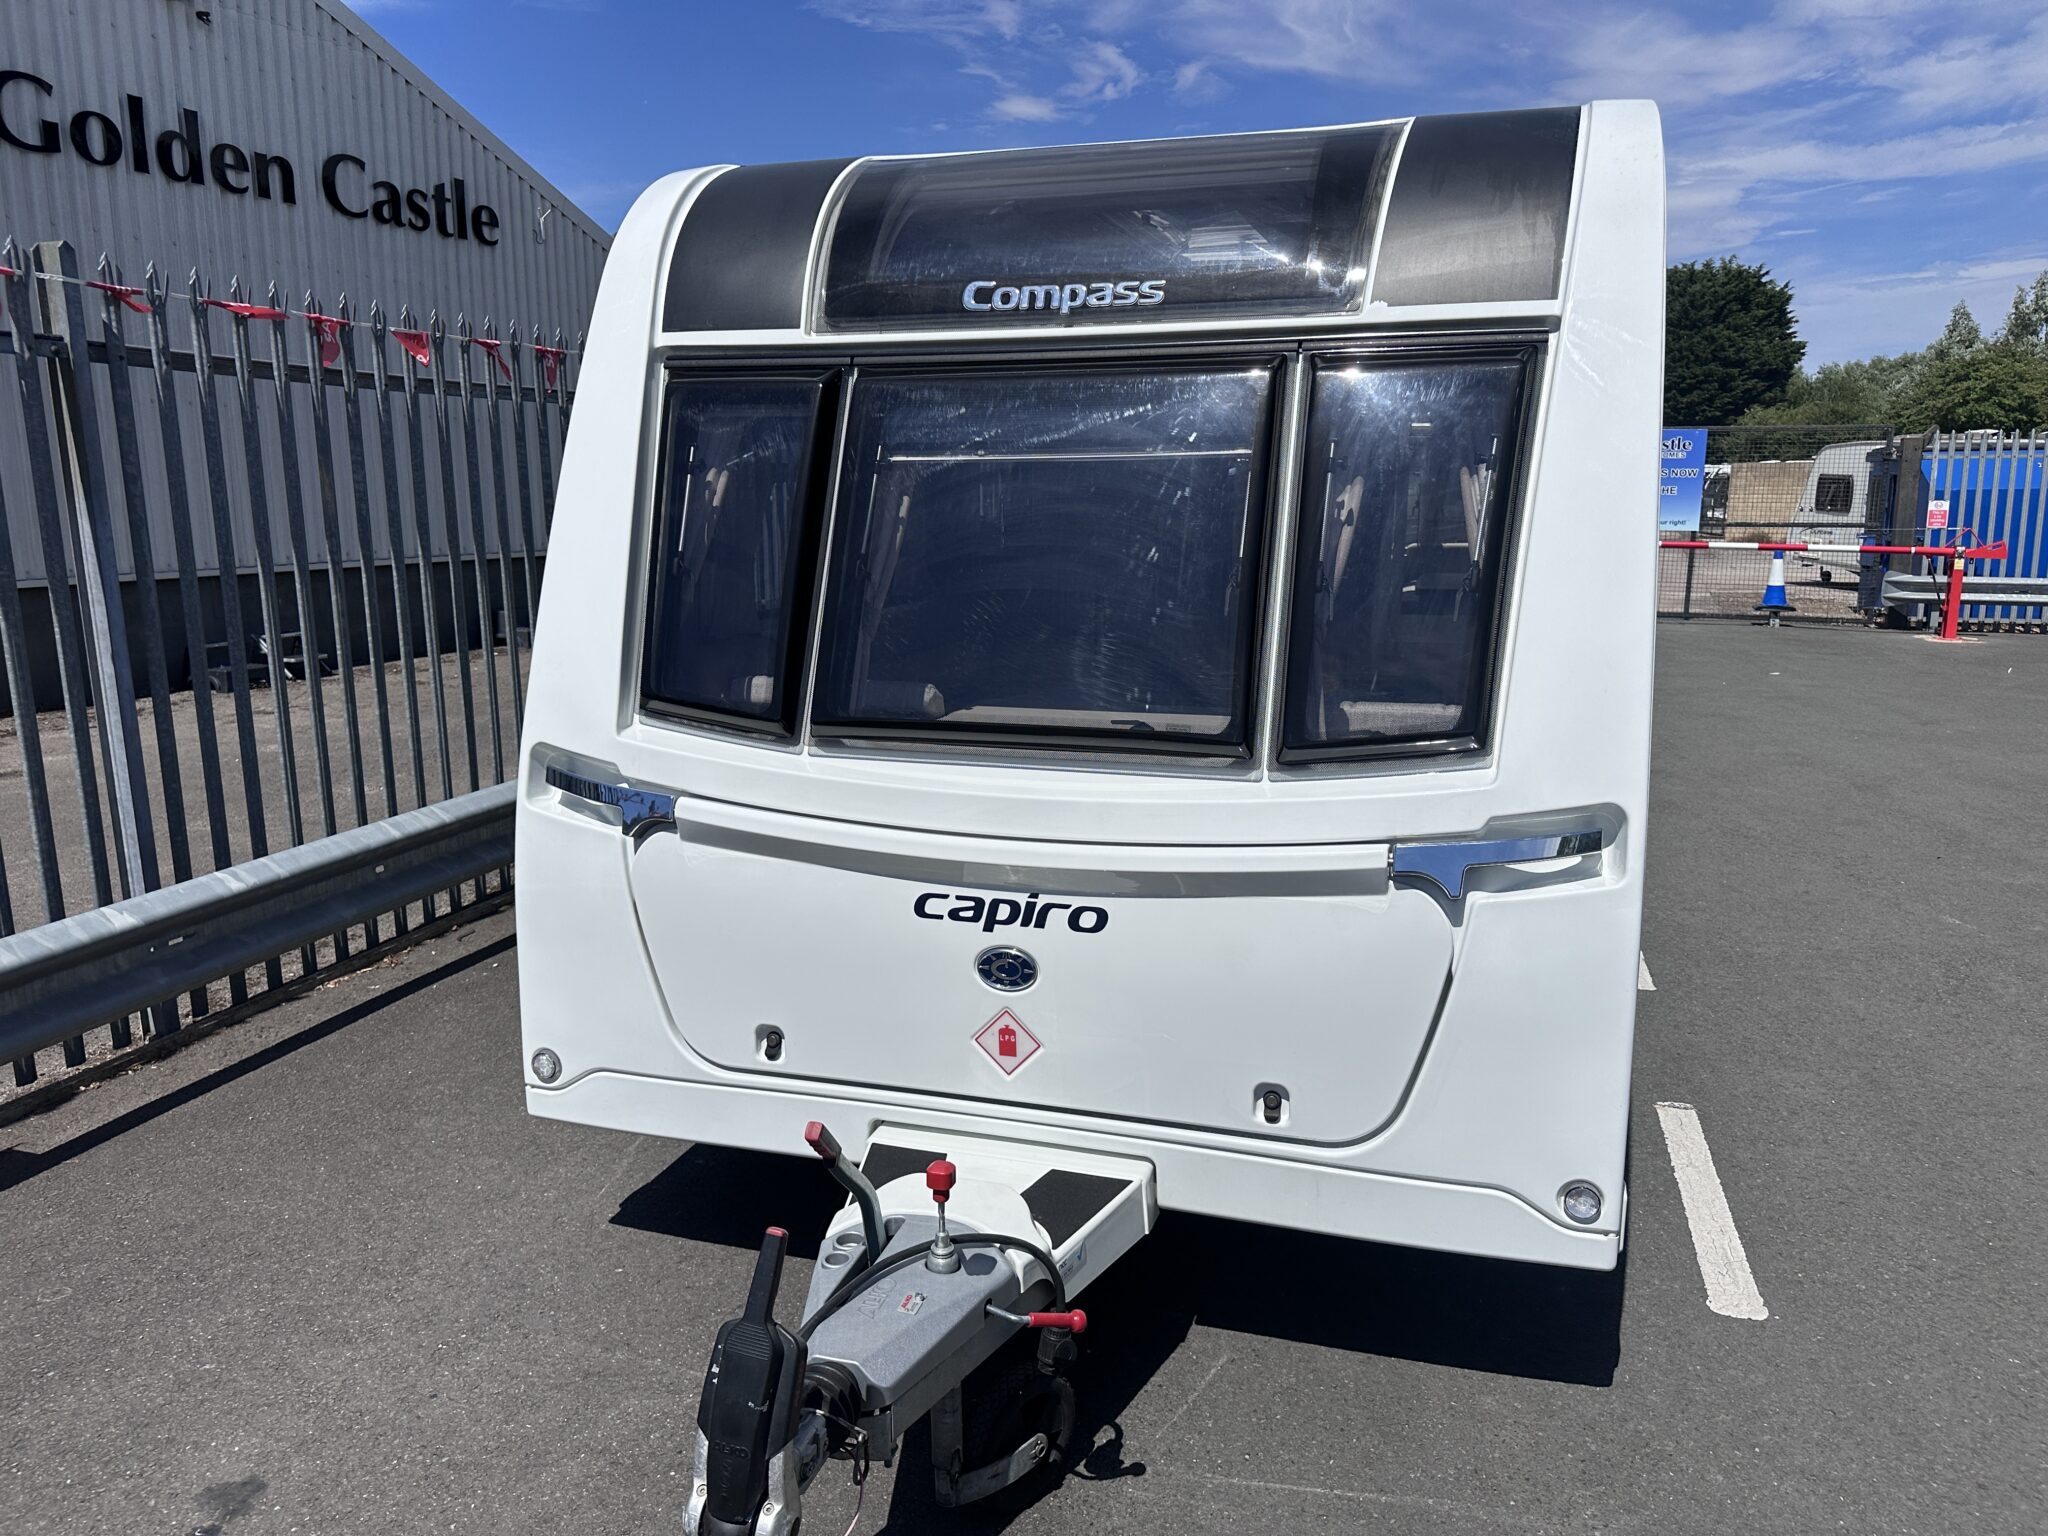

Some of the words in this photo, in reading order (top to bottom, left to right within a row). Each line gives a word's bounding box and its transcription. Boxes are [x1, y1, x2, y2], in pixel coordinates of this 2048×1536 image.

[0, 70, 296, 205] Golden
[322, 153, 500, 247] Castle
[962, 280, 1167, 315] Compass
[1671, 468, 1699, 478] NOW
[913, 892, 1109, 934] capiro
